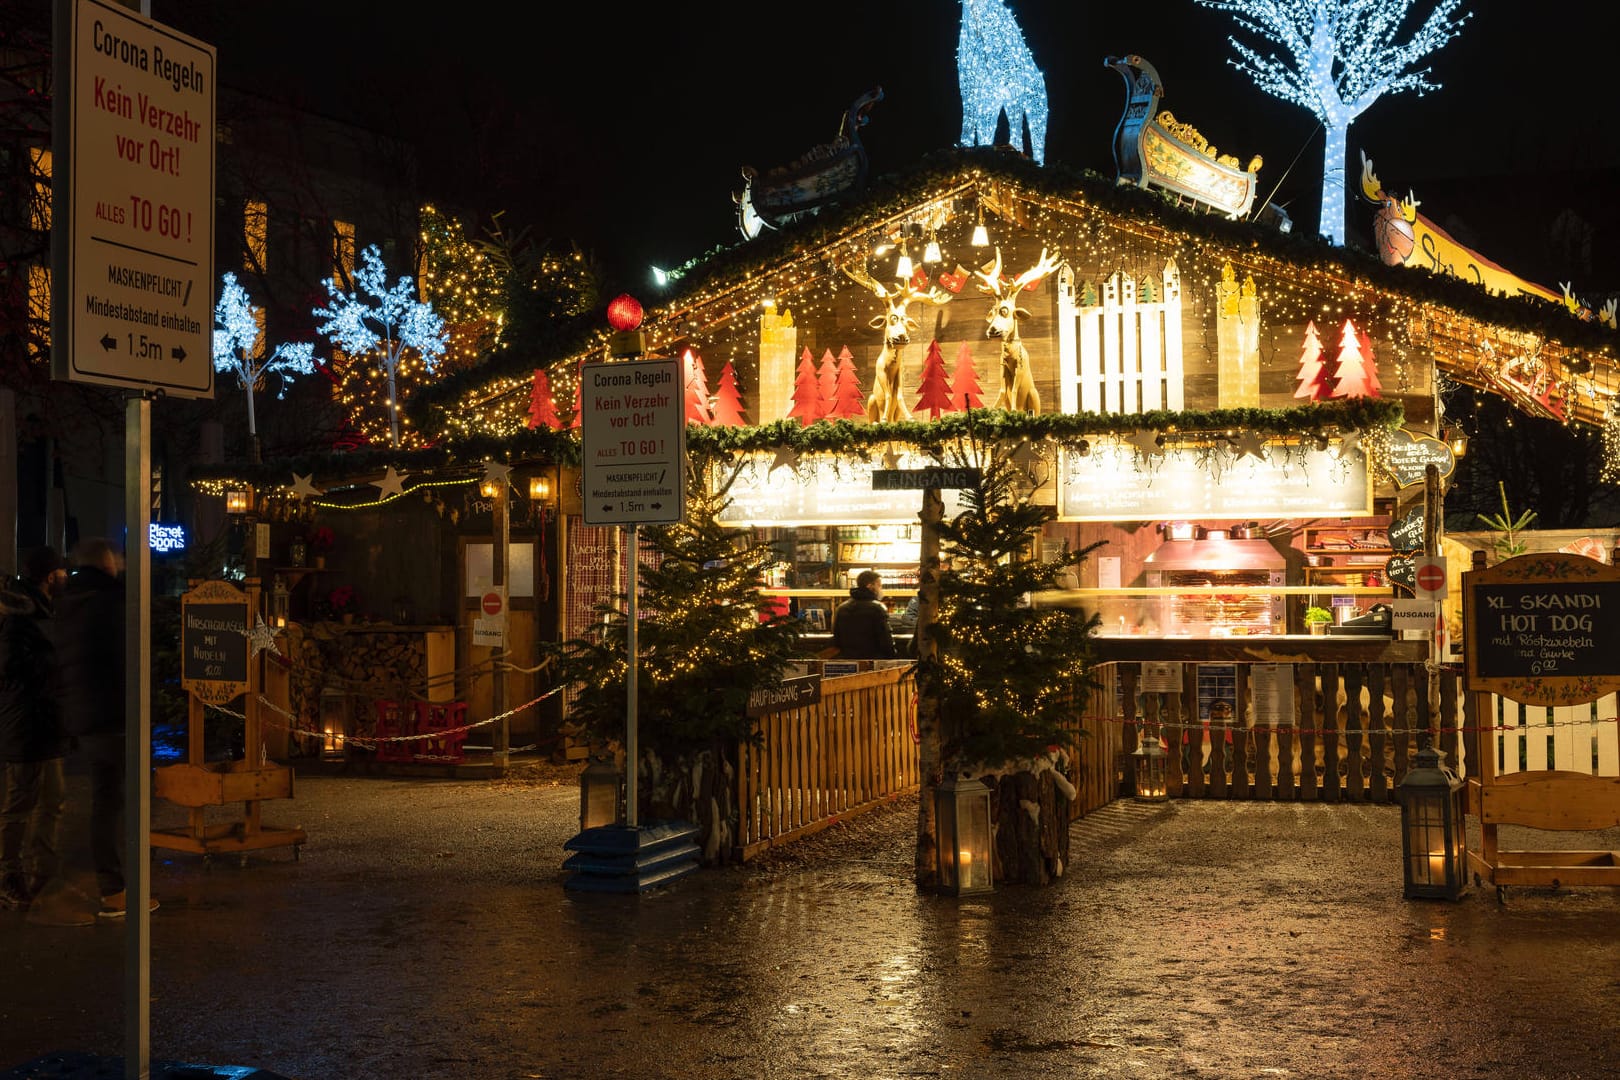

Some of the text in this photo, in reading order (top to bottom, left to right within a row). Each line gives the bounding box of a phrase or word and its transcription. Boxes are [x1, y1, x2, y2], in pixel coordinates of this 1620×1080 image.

[93, 20, 203, 94] Corona Regeln
[94, 75, 201, 143] Kein Verzehr
[116, 134, 180, 177] vor Ort!
[96, 201, 125, 225] ALLES
[130, 195, 152, 232] TO
[158, 204, 181, 240] GO
[86, 295, 201, 335] Mindestabstand einhalten
[594, 370, 671, 387] Corona Regeln
[595, 394, 670, 411] Kein Verzehr
[610, 412, 655, 428] vor Ort!
[597, 448, 617, 457] ALLES
[620, 441, 635, 456] TO
[639, 440, 656, 455] GO
[887, 472, 967, 488] EINGANG
[592, 488, 672, 498] Mindestabstand einhalten
[1486, 594, 1600, 610] XL SKANDI
[1501, 614, 1593, 632] HOT DOG
[1540, 648, 1575, 660] Gurke
[750, 685, 799, 708] HAUPTEINGANG
